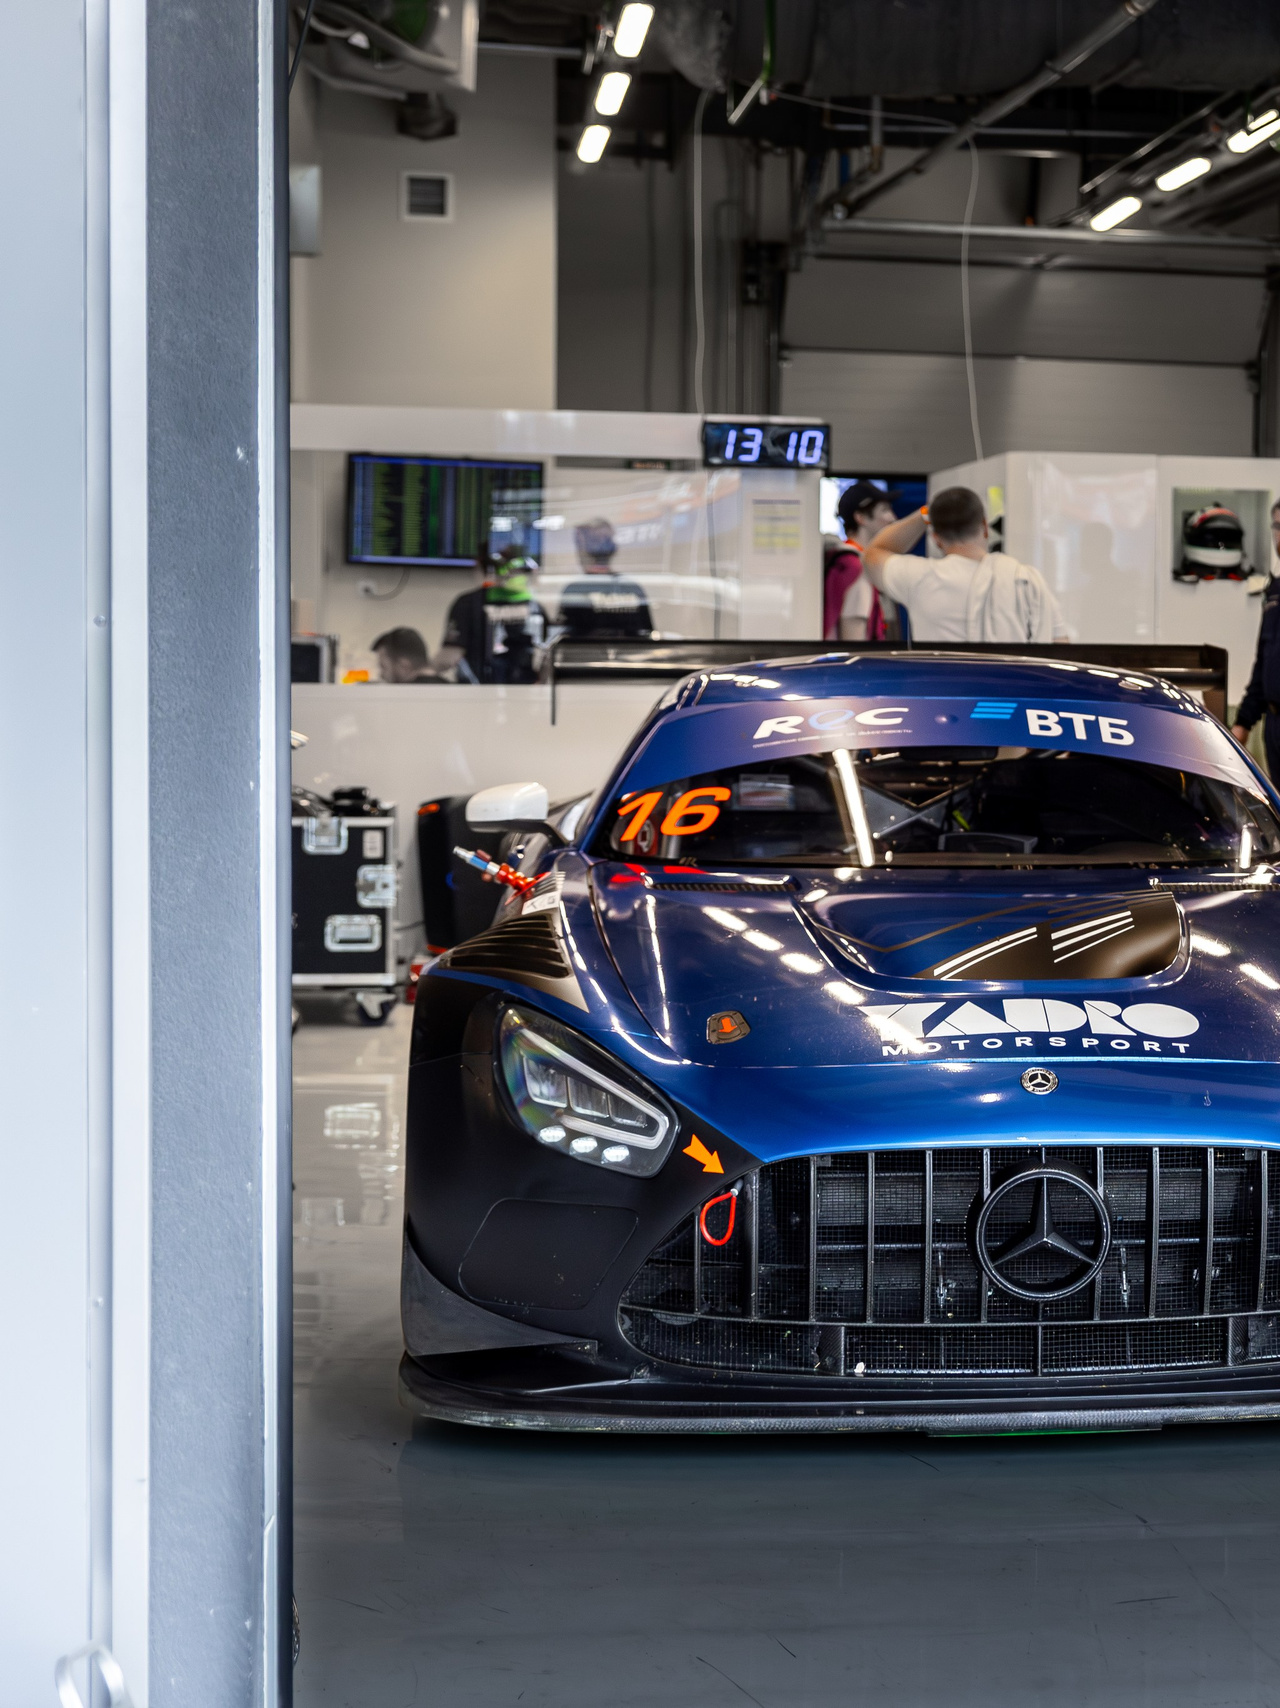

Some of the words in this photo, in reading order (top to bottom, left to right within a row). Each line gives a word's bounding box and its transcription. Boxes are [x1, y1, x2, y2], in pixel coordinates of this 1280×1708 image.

[725, 428, 763, 461] 13
[786, 430, 824, 464] 10
[1025, 709, 1135, 746] ВТБ
[617, 786, 731, 842] 16
[882, 1036, 1191, 1057] MOTORSPORT
